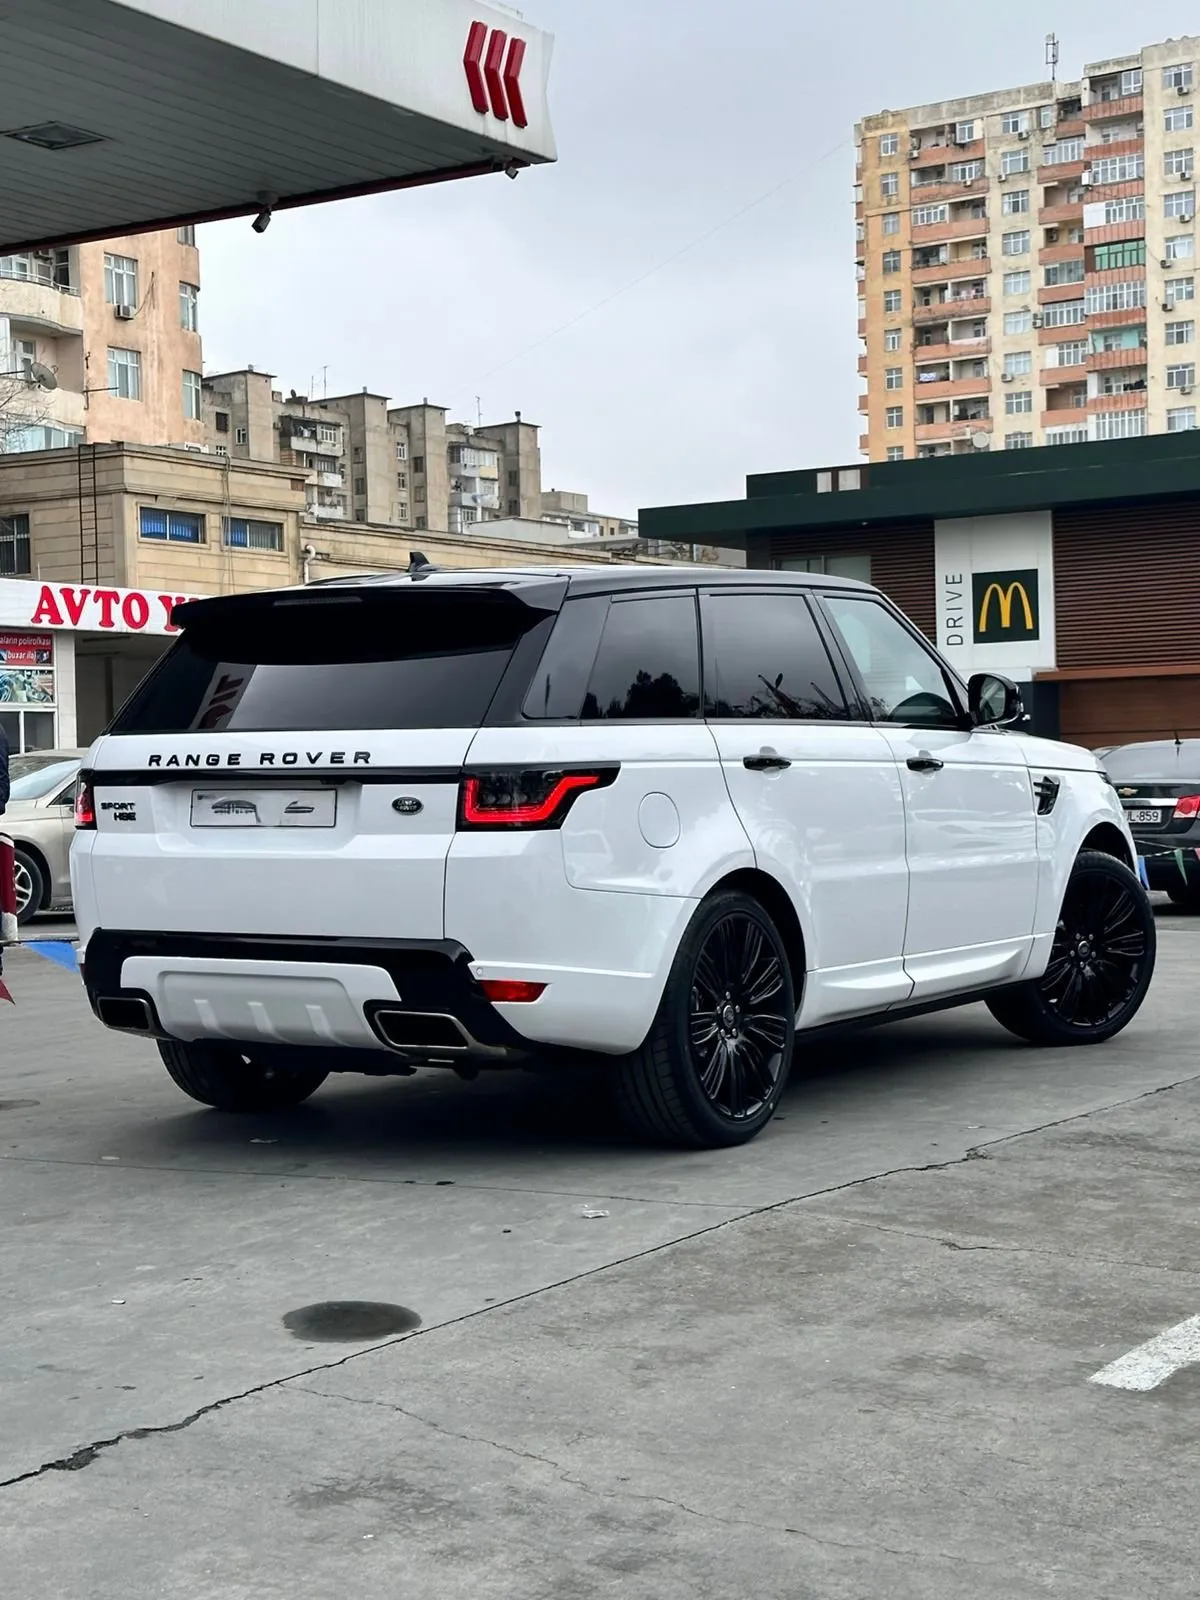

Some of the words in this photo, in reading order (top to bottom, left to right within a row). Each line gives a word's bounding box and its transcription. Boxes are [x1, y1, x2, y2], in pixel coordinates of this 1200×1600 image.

[31, 586, 149, 629] AVTO
[946, 573, 963, 645] DRIVE
[979, 581, 1033, 632] M
[148, 754, 241, 767] RANGE
[259, 752, 371, 765] ROVER
[100, 802, 135, 811] SPORT
[113, 812, 137, 821] HSE
